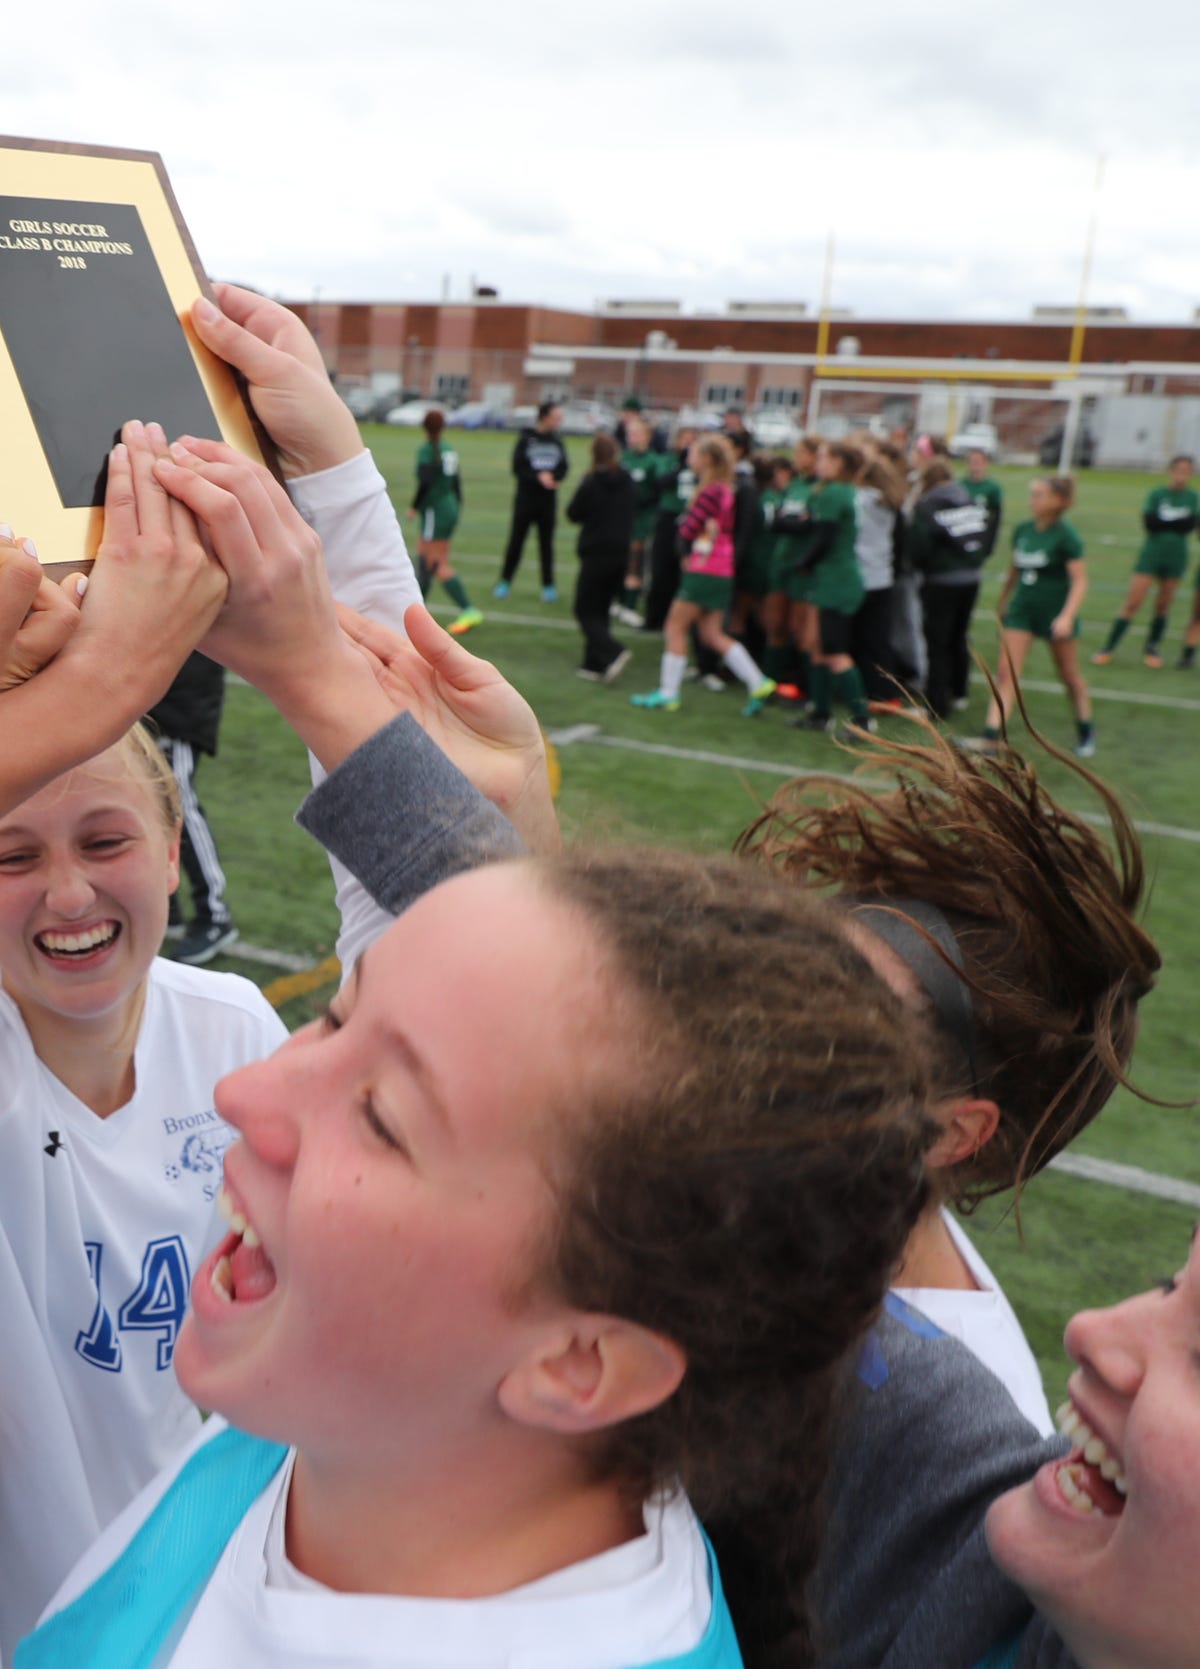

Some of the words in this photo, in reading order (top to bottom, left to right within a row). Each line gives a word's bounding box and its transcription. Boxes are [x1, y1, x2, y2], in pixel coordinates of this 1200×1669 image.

[9, 219, 52, 235] GIRLS
[53, 222, 109, 238] SOCCER
[41, 238, 53, 251] B
[54, 238, 134, 255] CHAMPIONS
[57, 255, 87, 269] 2018
[163, 1110, 216, 1135] Bronx
[75, 1235, 190, 1372] 14
